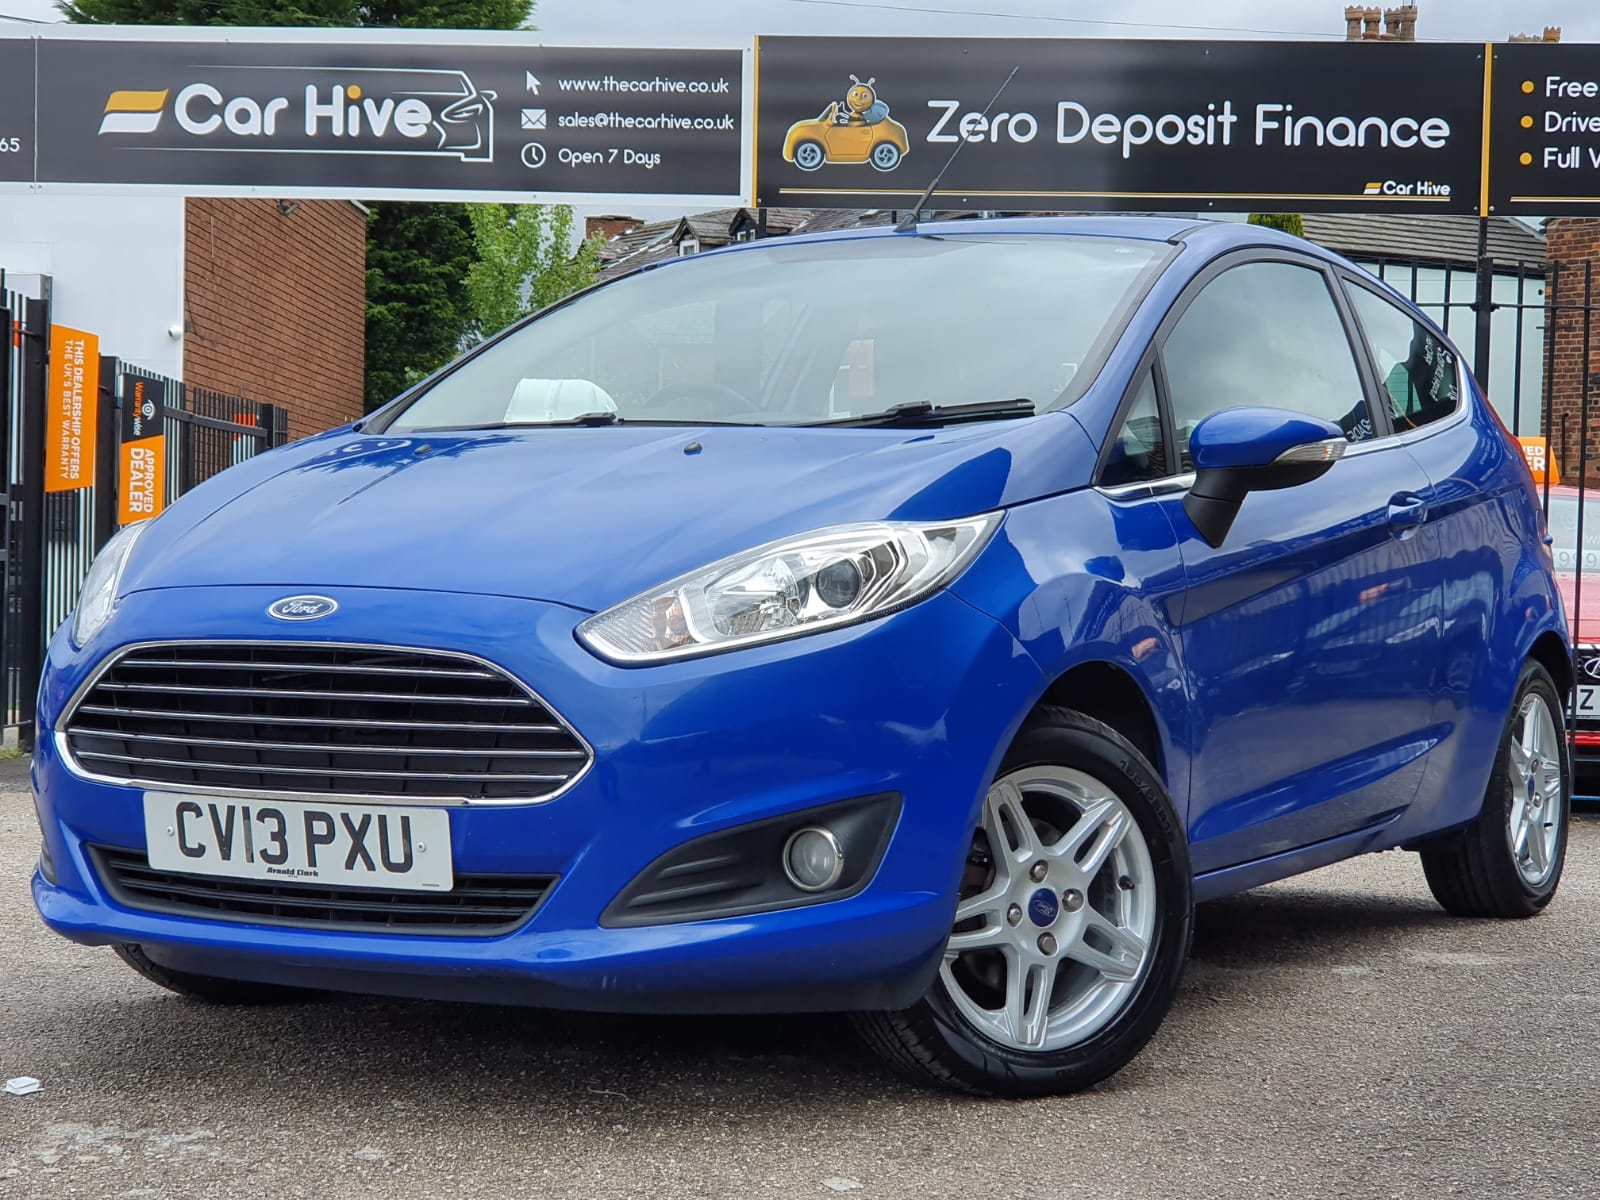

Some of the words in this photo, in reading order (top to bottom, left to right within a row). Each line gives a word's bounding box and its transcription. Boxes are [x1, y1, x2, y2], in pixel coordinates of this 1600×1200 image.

[558, 76, 729, 93] www.thecarhive.co.uk
[1545, 76, 1599, 97] Free
[174, 83, 289, 135] Car
[305, 84, 433, 137] Hive
[558, 112, 734, 129] sales@thecarhive.co.uk
[1544, 111, 1600, 132] Drive
[926, 100, 1038, 143] Zero
[1056, 100, 1238, 159] Deposit
[1255, 103, 1450, 149] Finance
[0, 137, 20, 153] 65
[558, 148, 604, 168] Open
[607, 149, 619, 163] 7
[623, 149, 661, 169] Days
[1543, 146, 1580, 168] Full
[1383, 180, 1413, 195] Car
[1416, 181, 1451, 196] Hive
[64, 340, 74, 360] THE
[74, 340, 85, 365] THIS
[63, 363, 73, 387] UK'S
[62, 390, 72, 417] BEST
[72, 367, 83, 435] DEALERSHIP
[60, 420, 71, 478] WARRANTY
[70, 437, 81, 479] OFFERS
[129, 447, 145, 513] DEALER
[144, 448, 155, 513] APPROVED
[281, 599, 323, 614] Ford
[175, 801, 289, 866] CV13
[302, 810, 414, 874] PXU
[266, 867, 295, 875] Arnold
